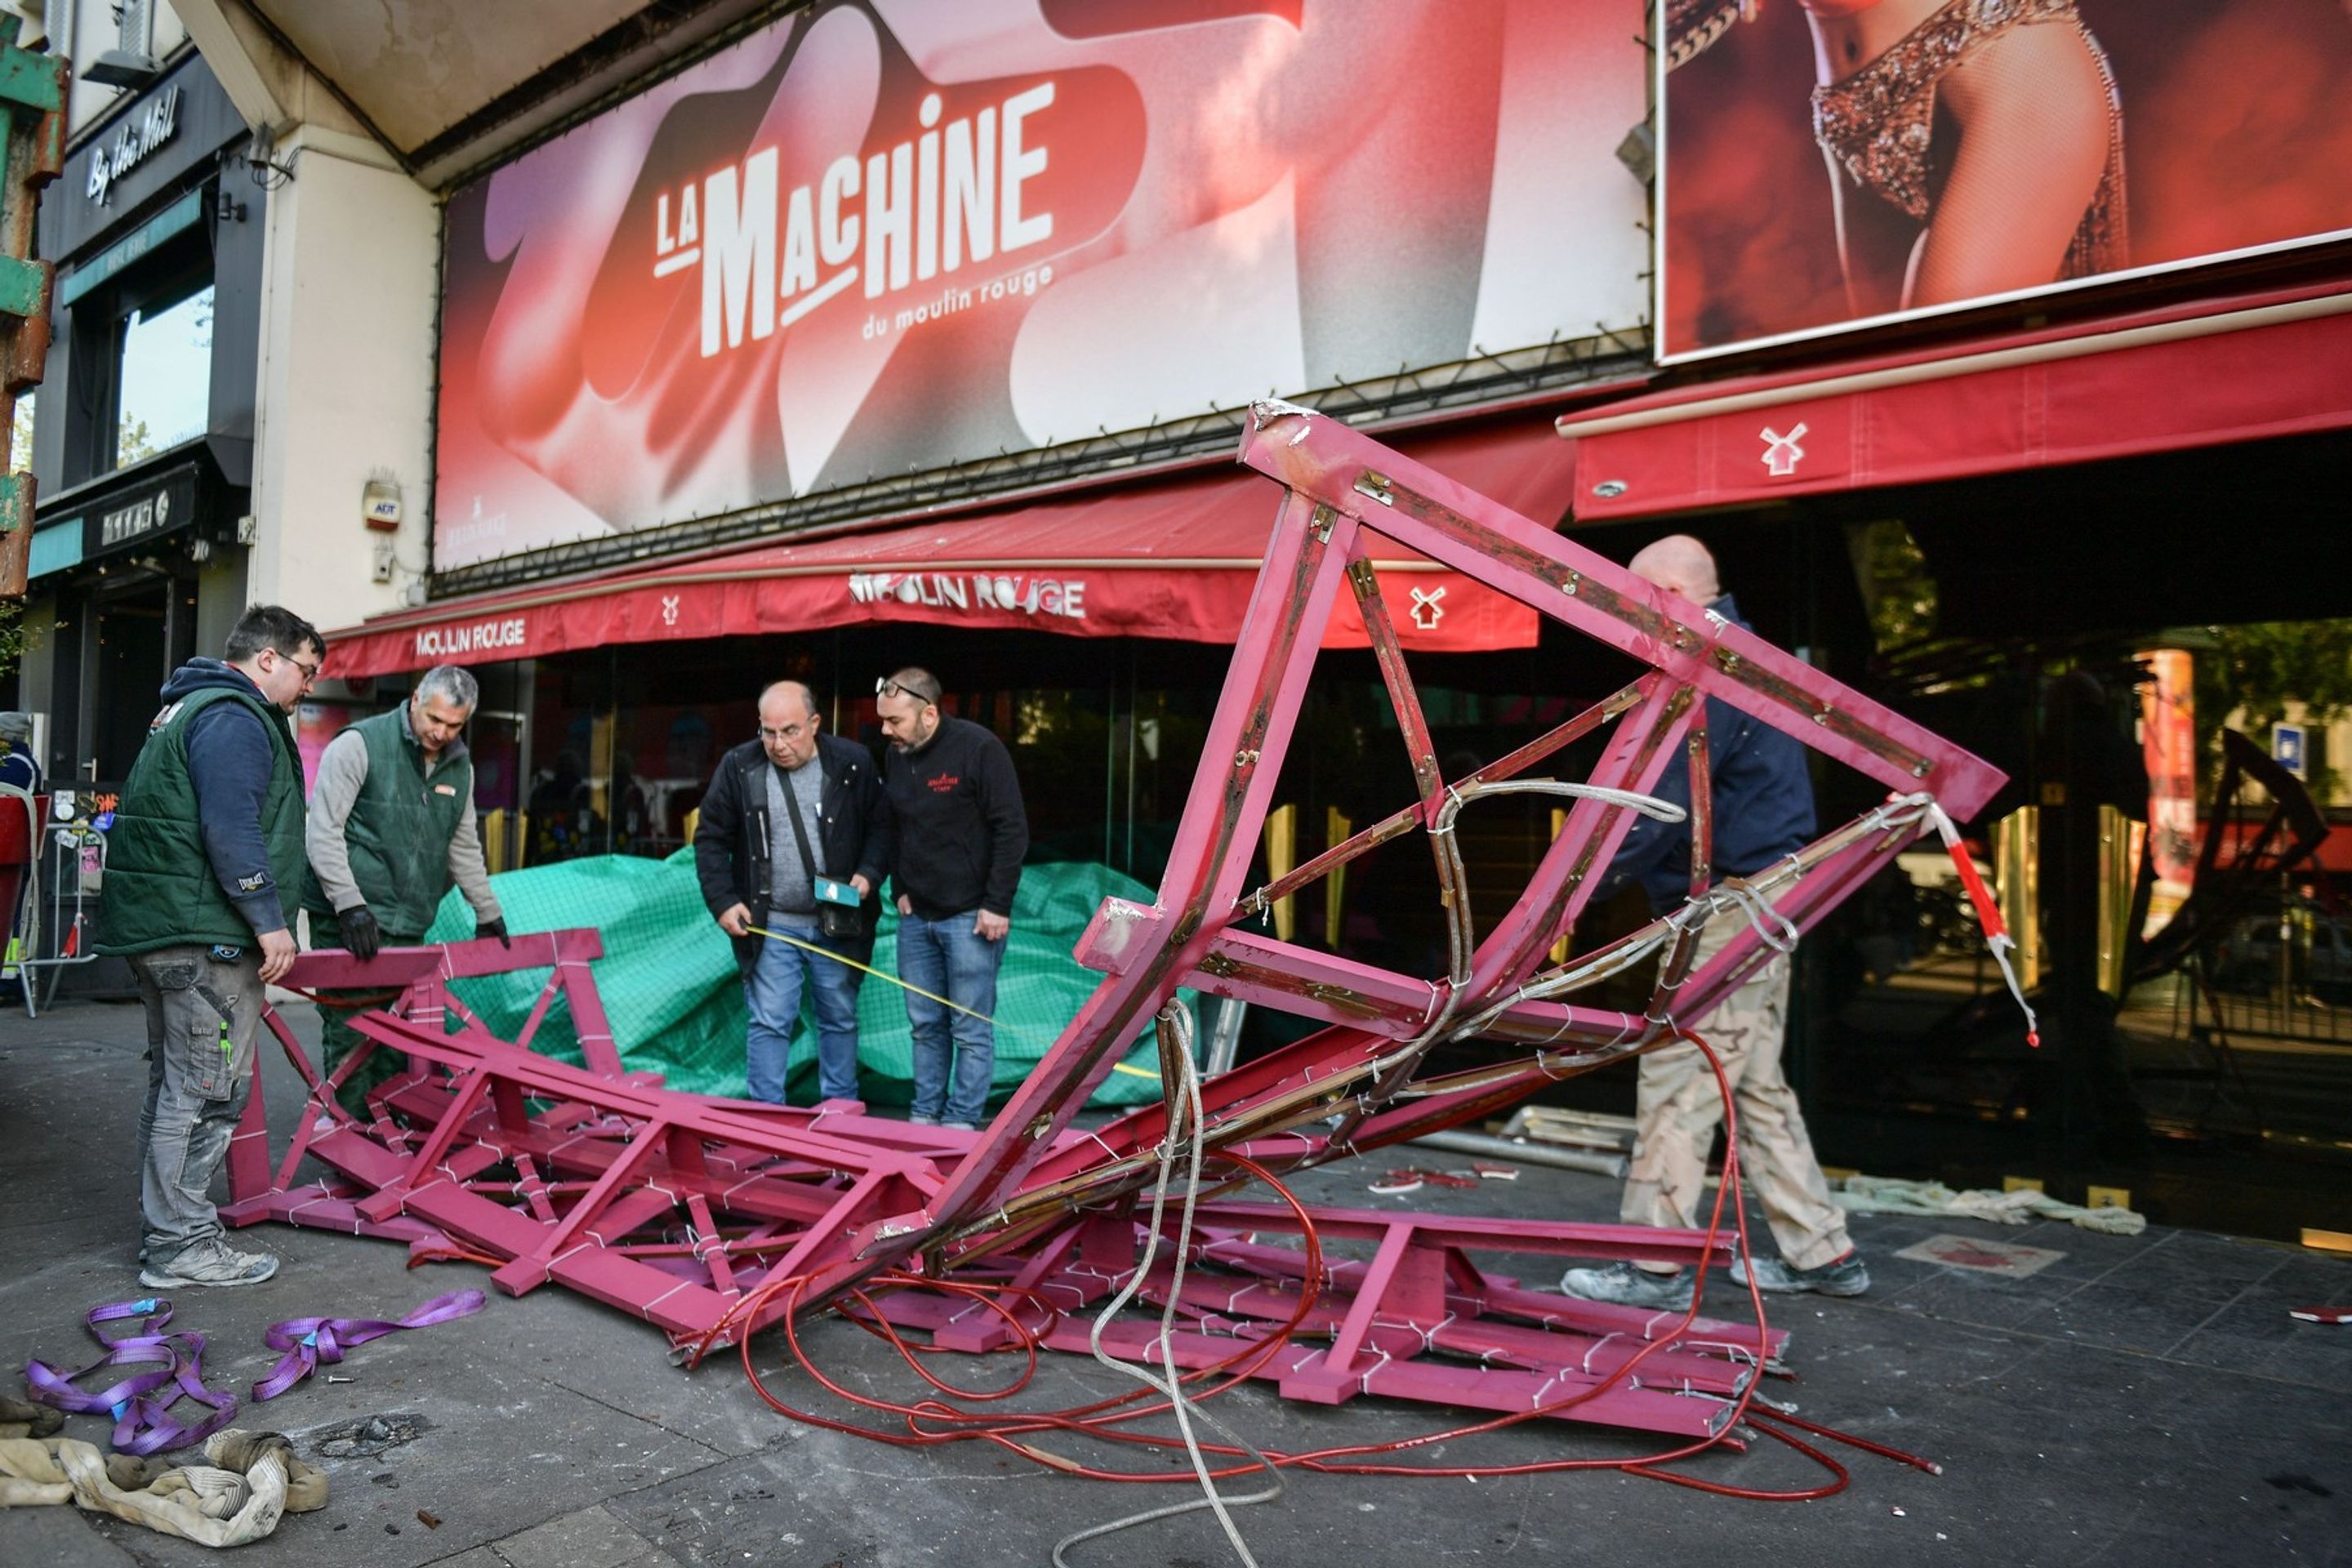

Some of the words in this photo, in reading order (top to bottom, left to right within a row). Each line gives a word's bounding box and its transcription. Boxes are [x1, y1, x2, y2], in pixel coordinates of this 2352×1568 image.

[87, 148, 110, 207] By
[111, 124, 138, 180] the
[137, 84, 179, 161] Mill
[657, 183, 698, 255] LA
[862, 314, 887, 340] du
[895, 288, 971, 329] moulin
[980, 265, 1053, 304] rouge
[375, 502, 396, 515] ADT
[416, 627, 471, 657] MOULIN
[473, 618, 525, 650] ROUGE
